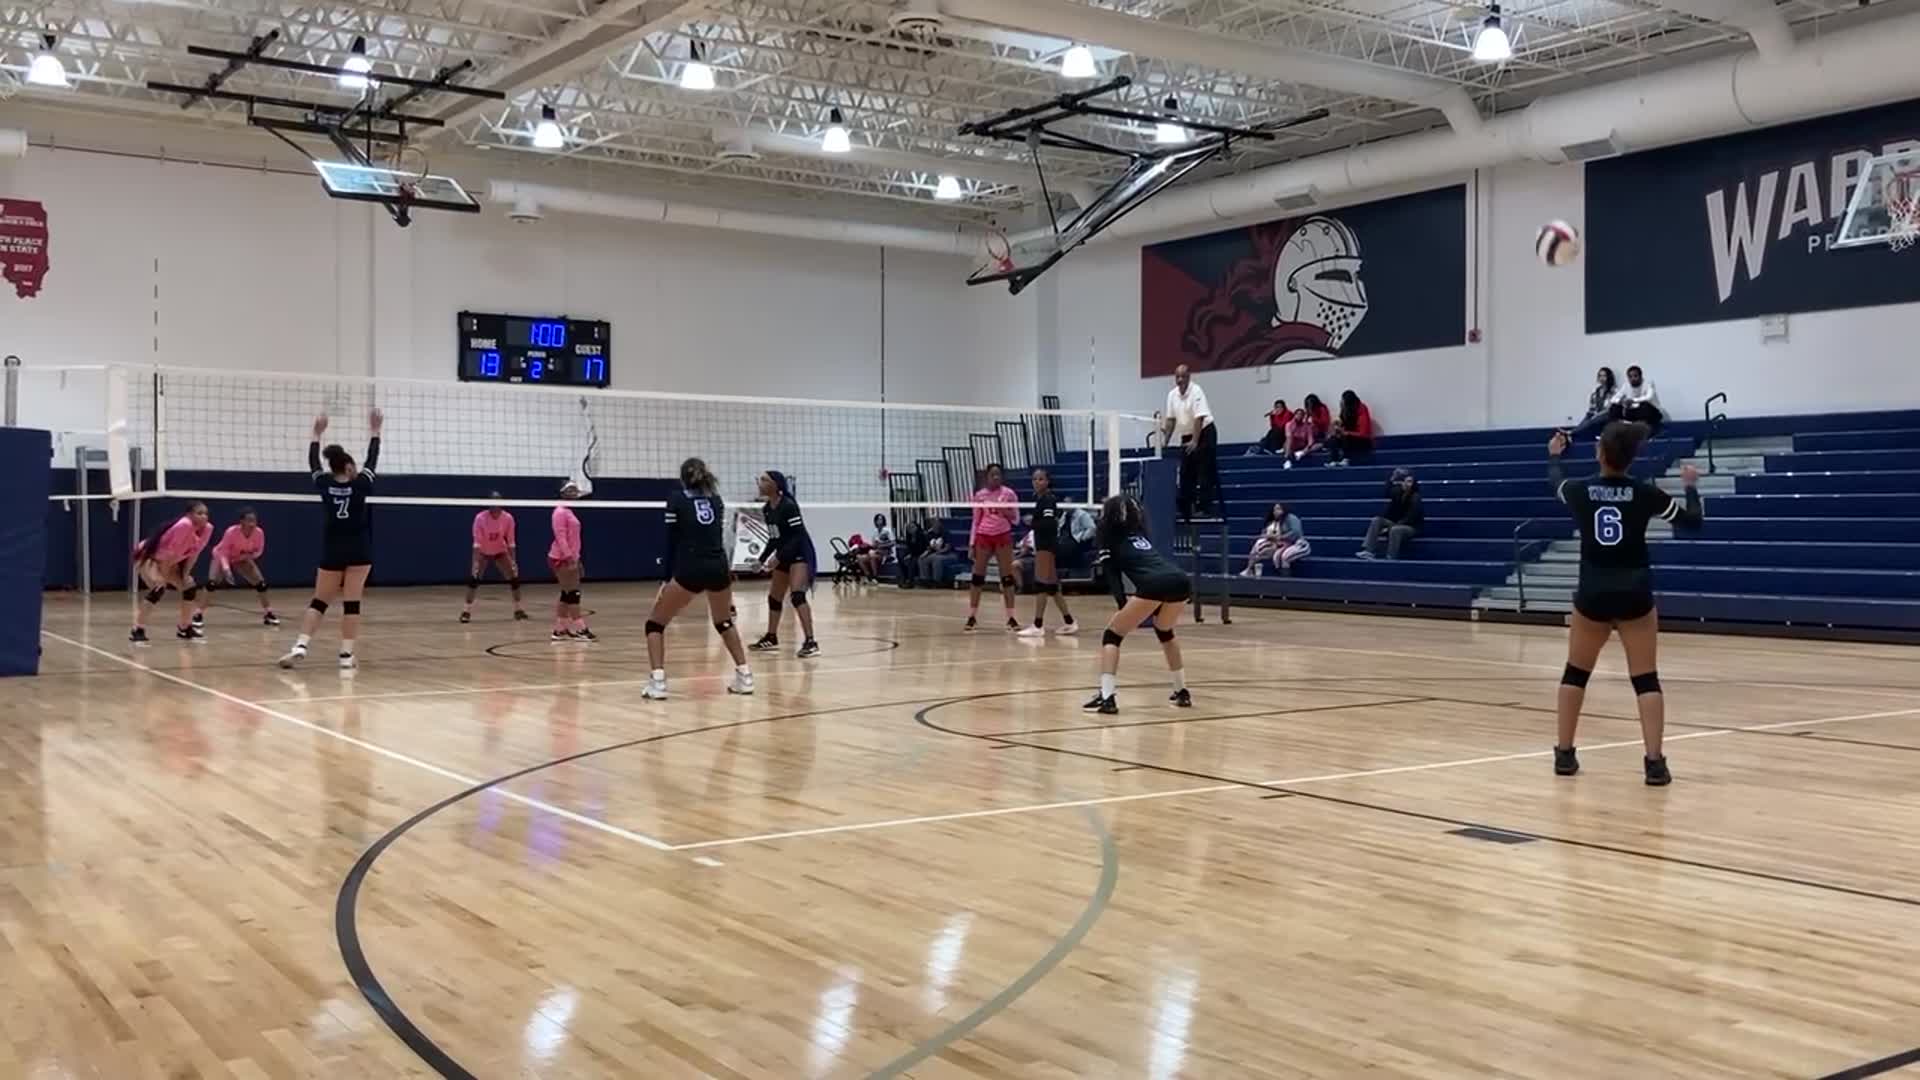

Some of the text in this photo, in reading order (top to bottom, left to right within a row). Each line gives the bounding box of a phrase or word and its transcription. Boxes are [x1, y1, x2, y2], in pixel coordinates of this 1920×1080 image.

[9, 245, 39, 254] STATE
[470, 337, 602, 355] HOME GUEST
[480, 353, 500, 377] 13
[531, 361, 542, 378] 2
[585, 358, 604, 381] 17
[333, 497, 350, 519] 7
[694, 498, 715, 524] 5
[1593, 506, 1623, 546] 6
